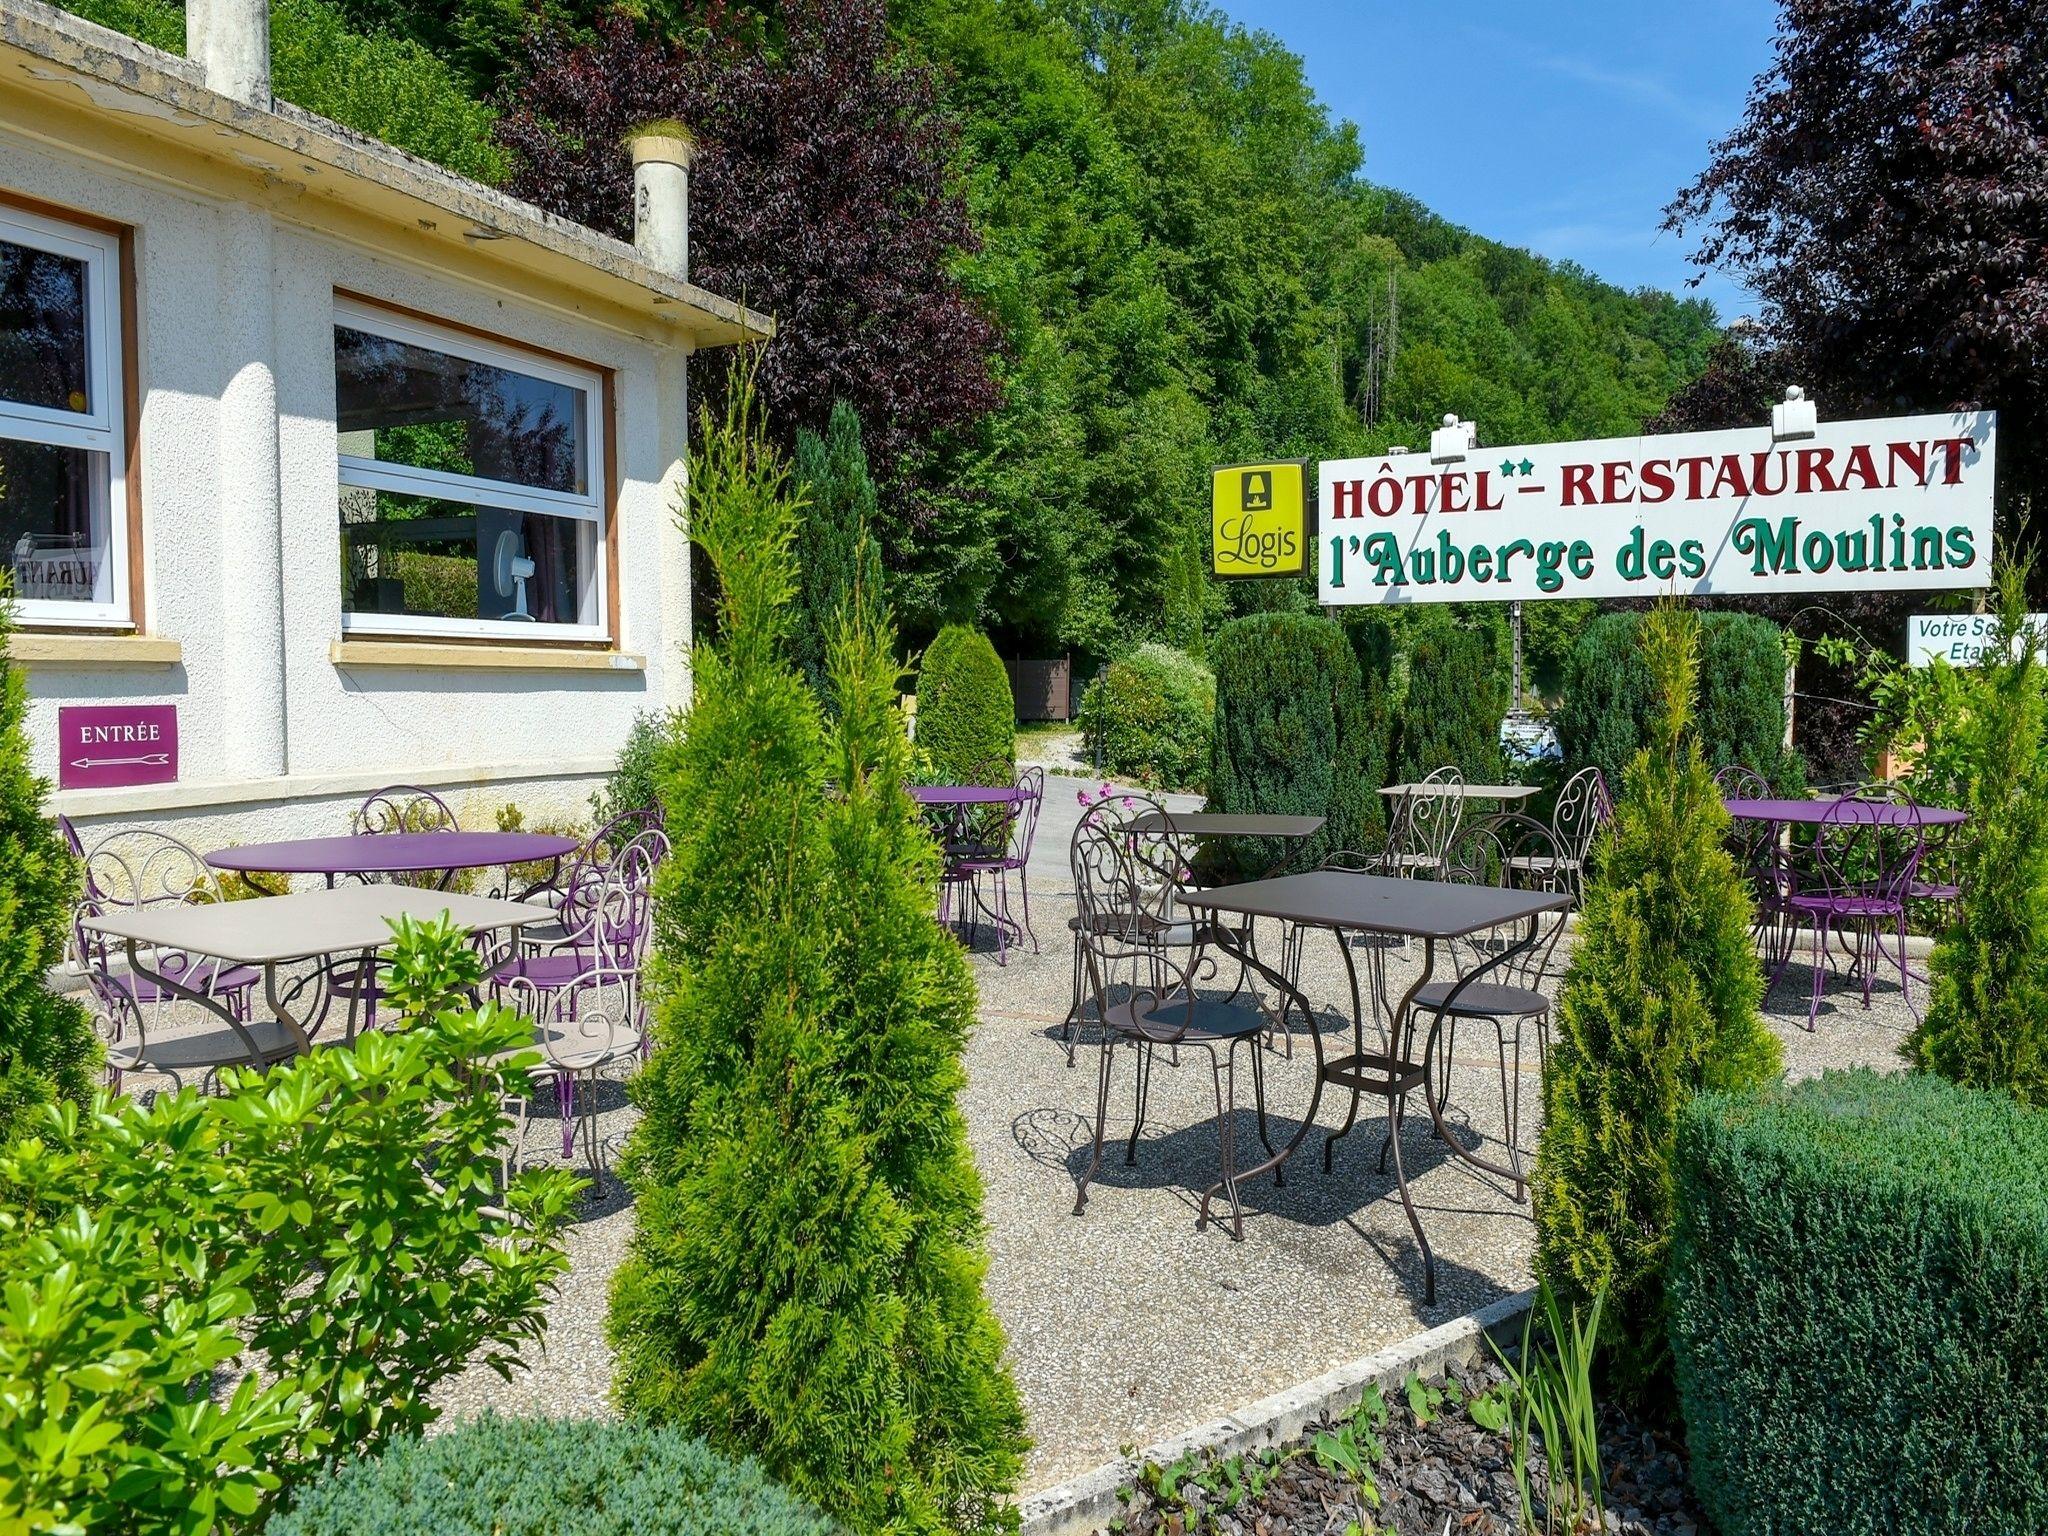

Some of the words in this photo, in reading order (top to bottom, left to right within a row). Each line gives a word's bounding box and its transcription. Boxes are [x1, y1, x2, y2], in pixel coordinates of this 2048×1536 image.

[1332, 462, 1505, 519] HÔTEL
[1560, 437, 1976, 506] RESTAURANT
[1217, 513, 1297, 568] Logis
[1330, 529, 1595, 593] l'Auberge
[1616, 525, 1707, 581] des
[1732, 512, 1976, 577] Moulins
[1919, 620, 1967, 637] Votre
[80, 721, 160, 744] ENTRÉE
